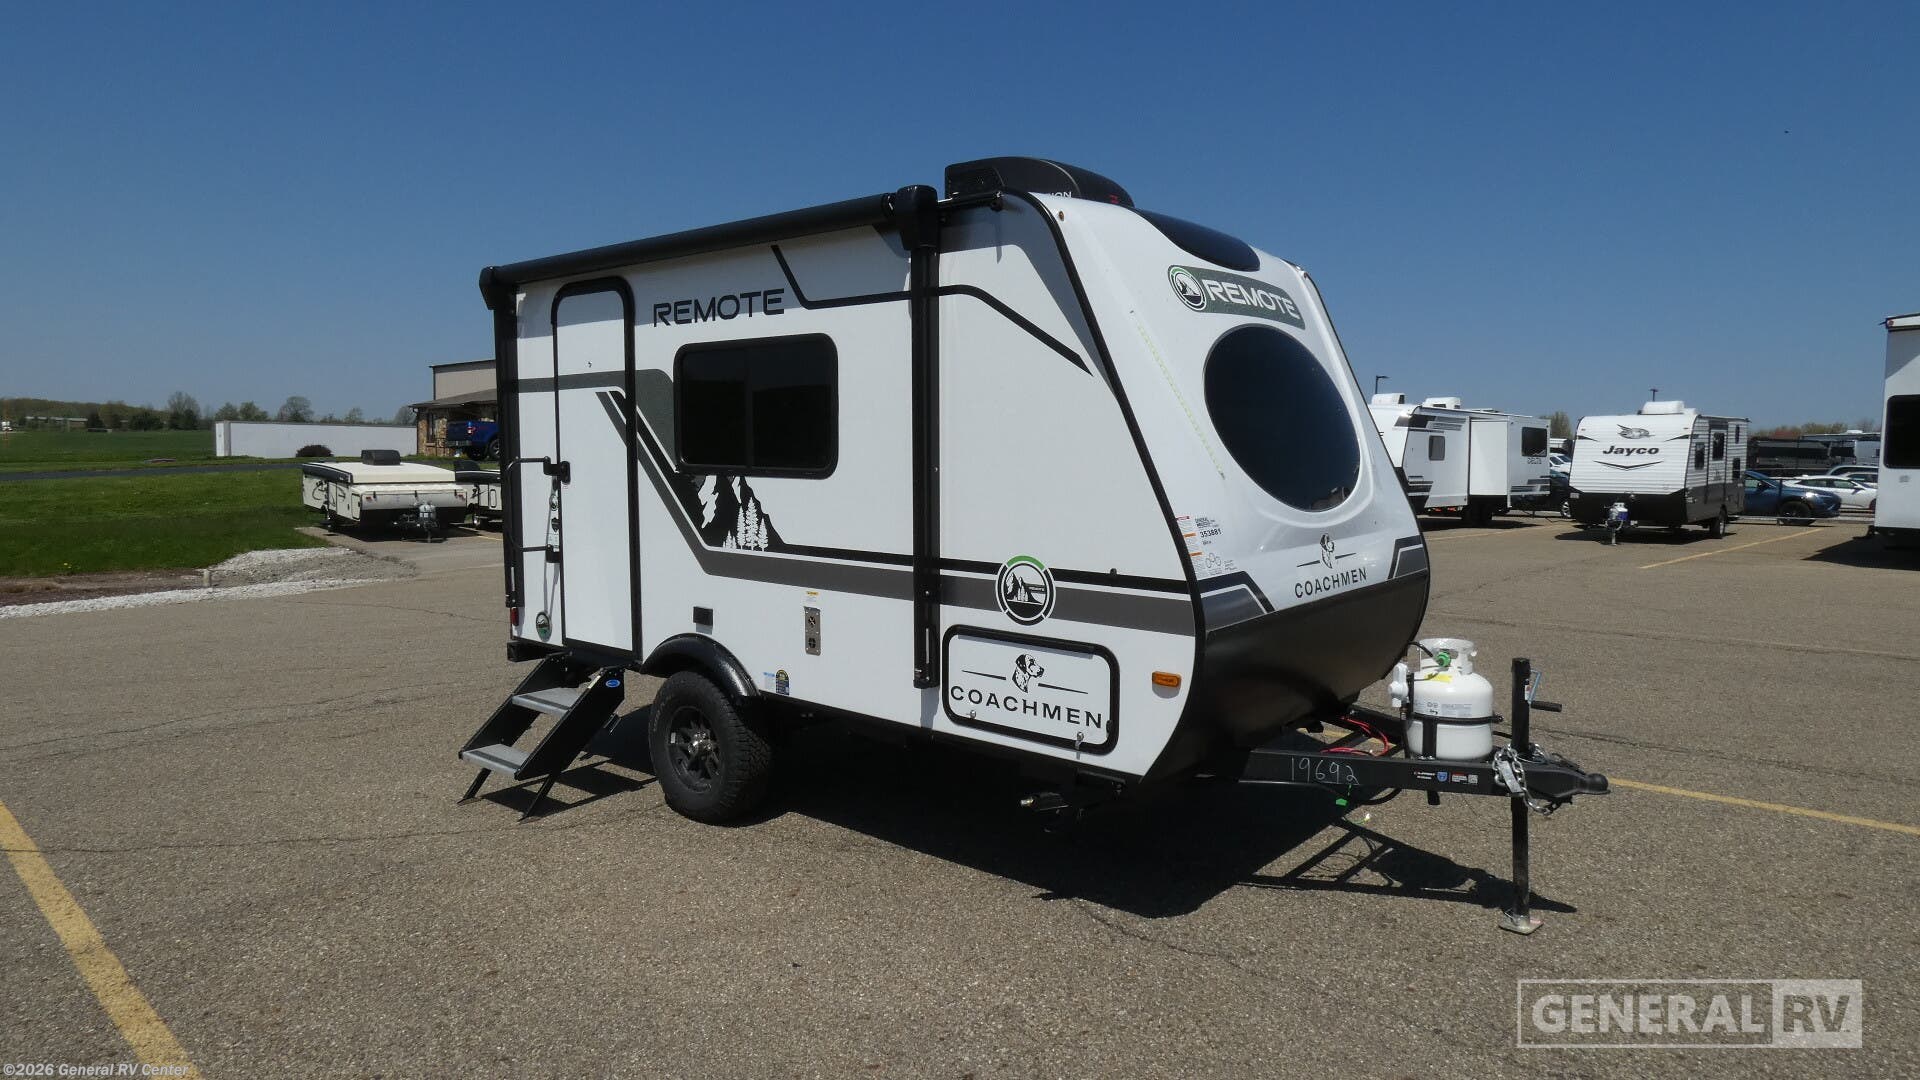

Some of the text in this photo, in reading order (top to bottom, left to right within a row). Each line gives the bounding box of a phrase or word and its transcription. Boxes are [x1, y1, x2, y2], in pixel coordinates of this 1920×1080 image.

[653, 288, 785, 327] REMOTE
[1201, 279, 1300, 319] REMOTE
[1602, 445, 1660, 456] Jayco
[1294, 567, 1367, 598] COACHMEN
[950, 685, 1102, 729] COACHMEN
[1291, 757, 1360, 785] 19692
